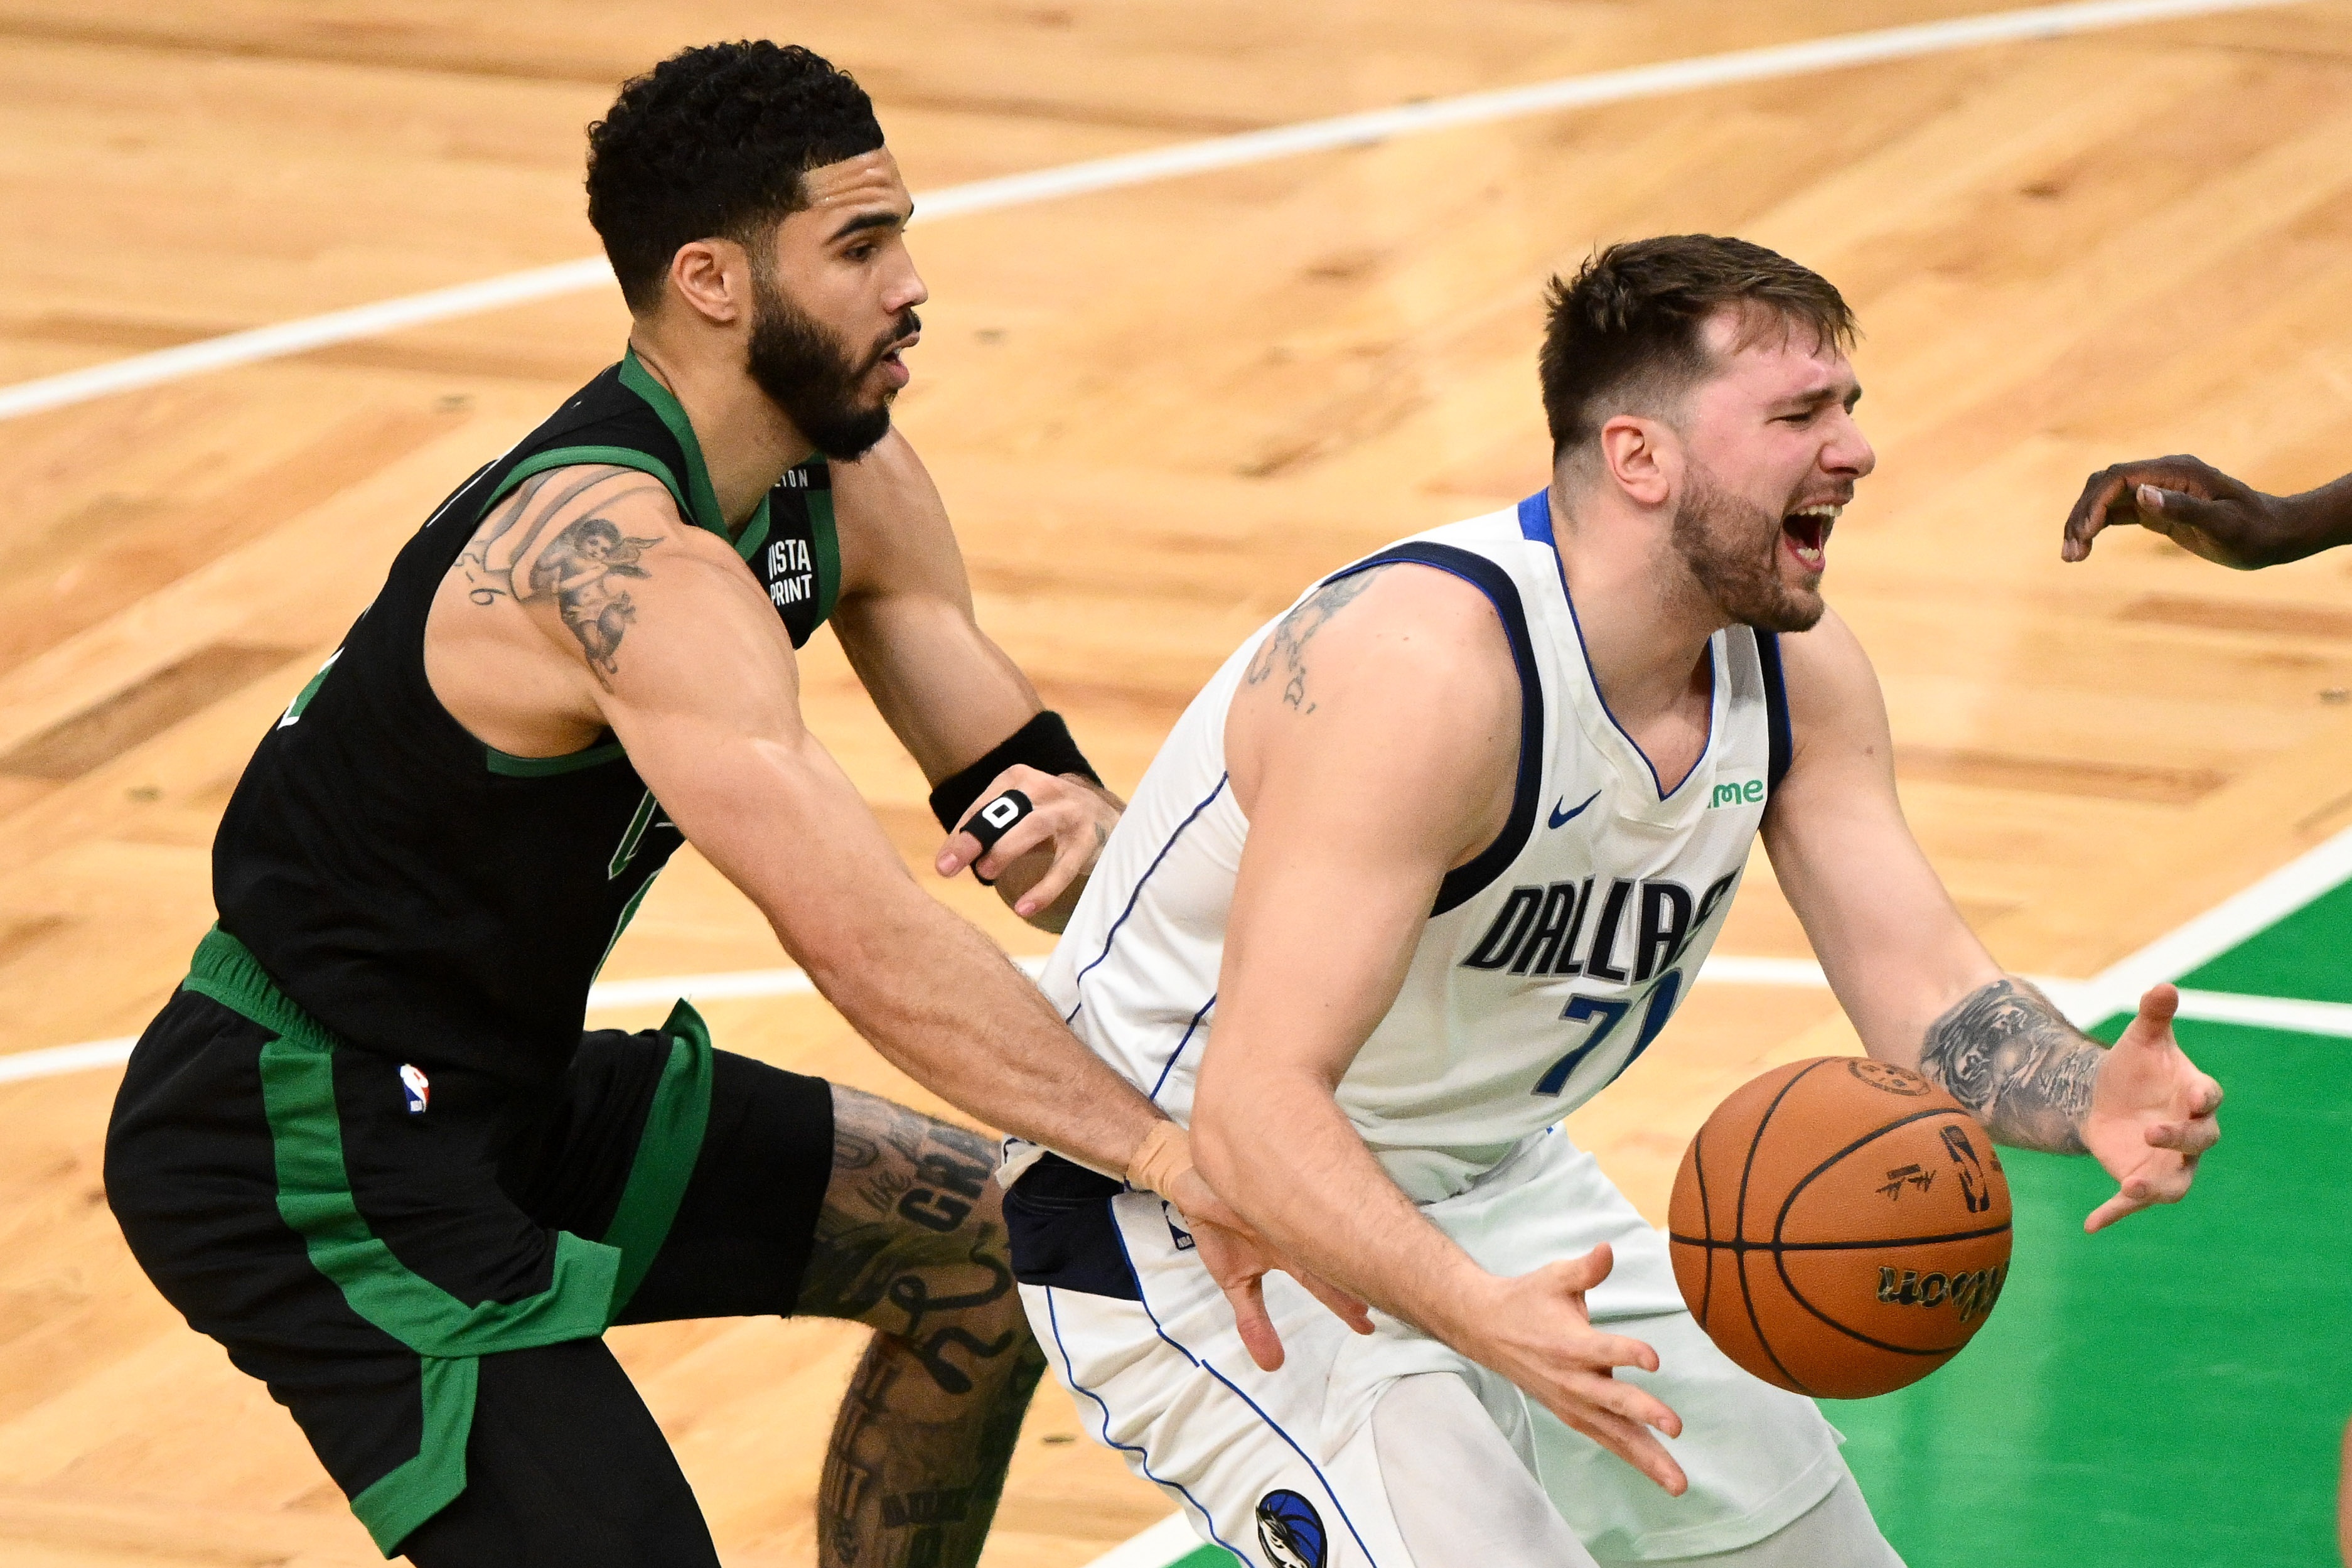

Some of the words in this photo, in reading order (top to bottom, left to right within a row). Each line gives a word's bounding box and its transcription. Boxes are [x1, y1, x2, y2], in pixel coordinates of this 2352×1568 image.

[770, 573, 813, 606] PRINT
[1707, 779, 1764, 808] me
[1875, 1259, 2009, 1324] ilson
